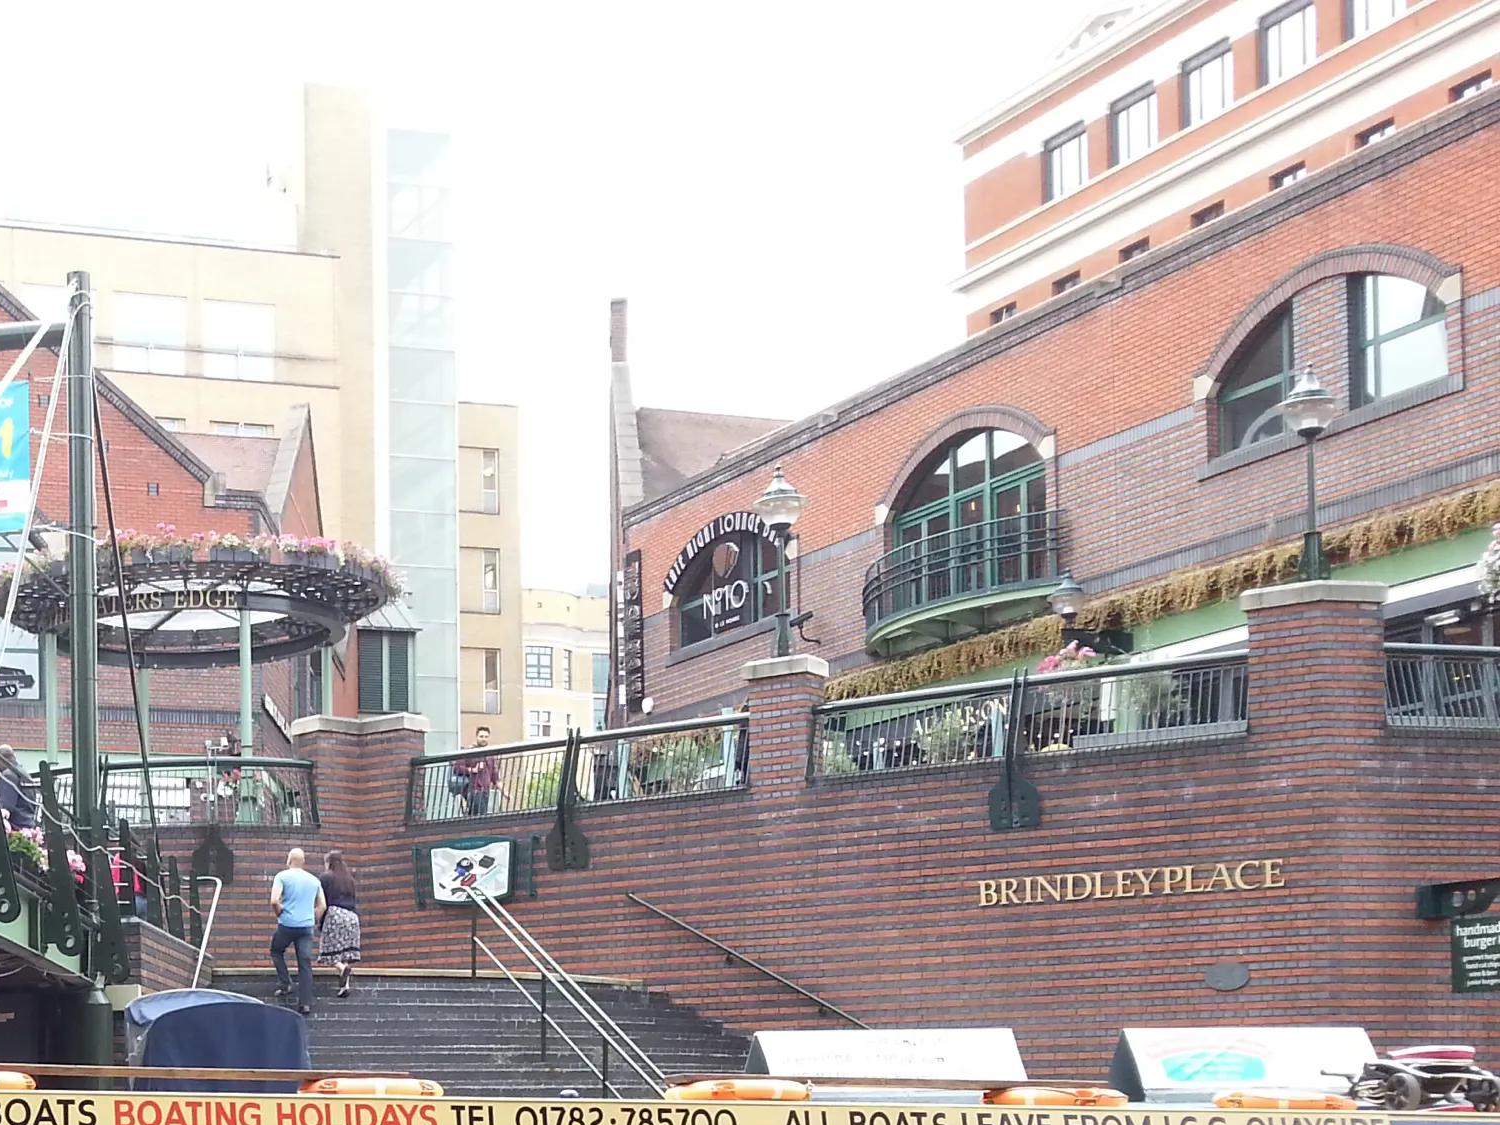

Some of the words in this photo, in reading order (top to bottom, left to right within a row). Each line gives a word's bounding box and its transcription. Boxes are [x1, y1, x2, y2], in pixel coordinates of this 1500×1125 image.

[719, 512, 760, 535] LOUNGE
[98, 591, 162, 615] ATERS
[173, 589, 238, 608] EDGE
[978, 859, 1286, 907] BRINDLEYPLACE
[1464, 936, 1497, 950] burger
